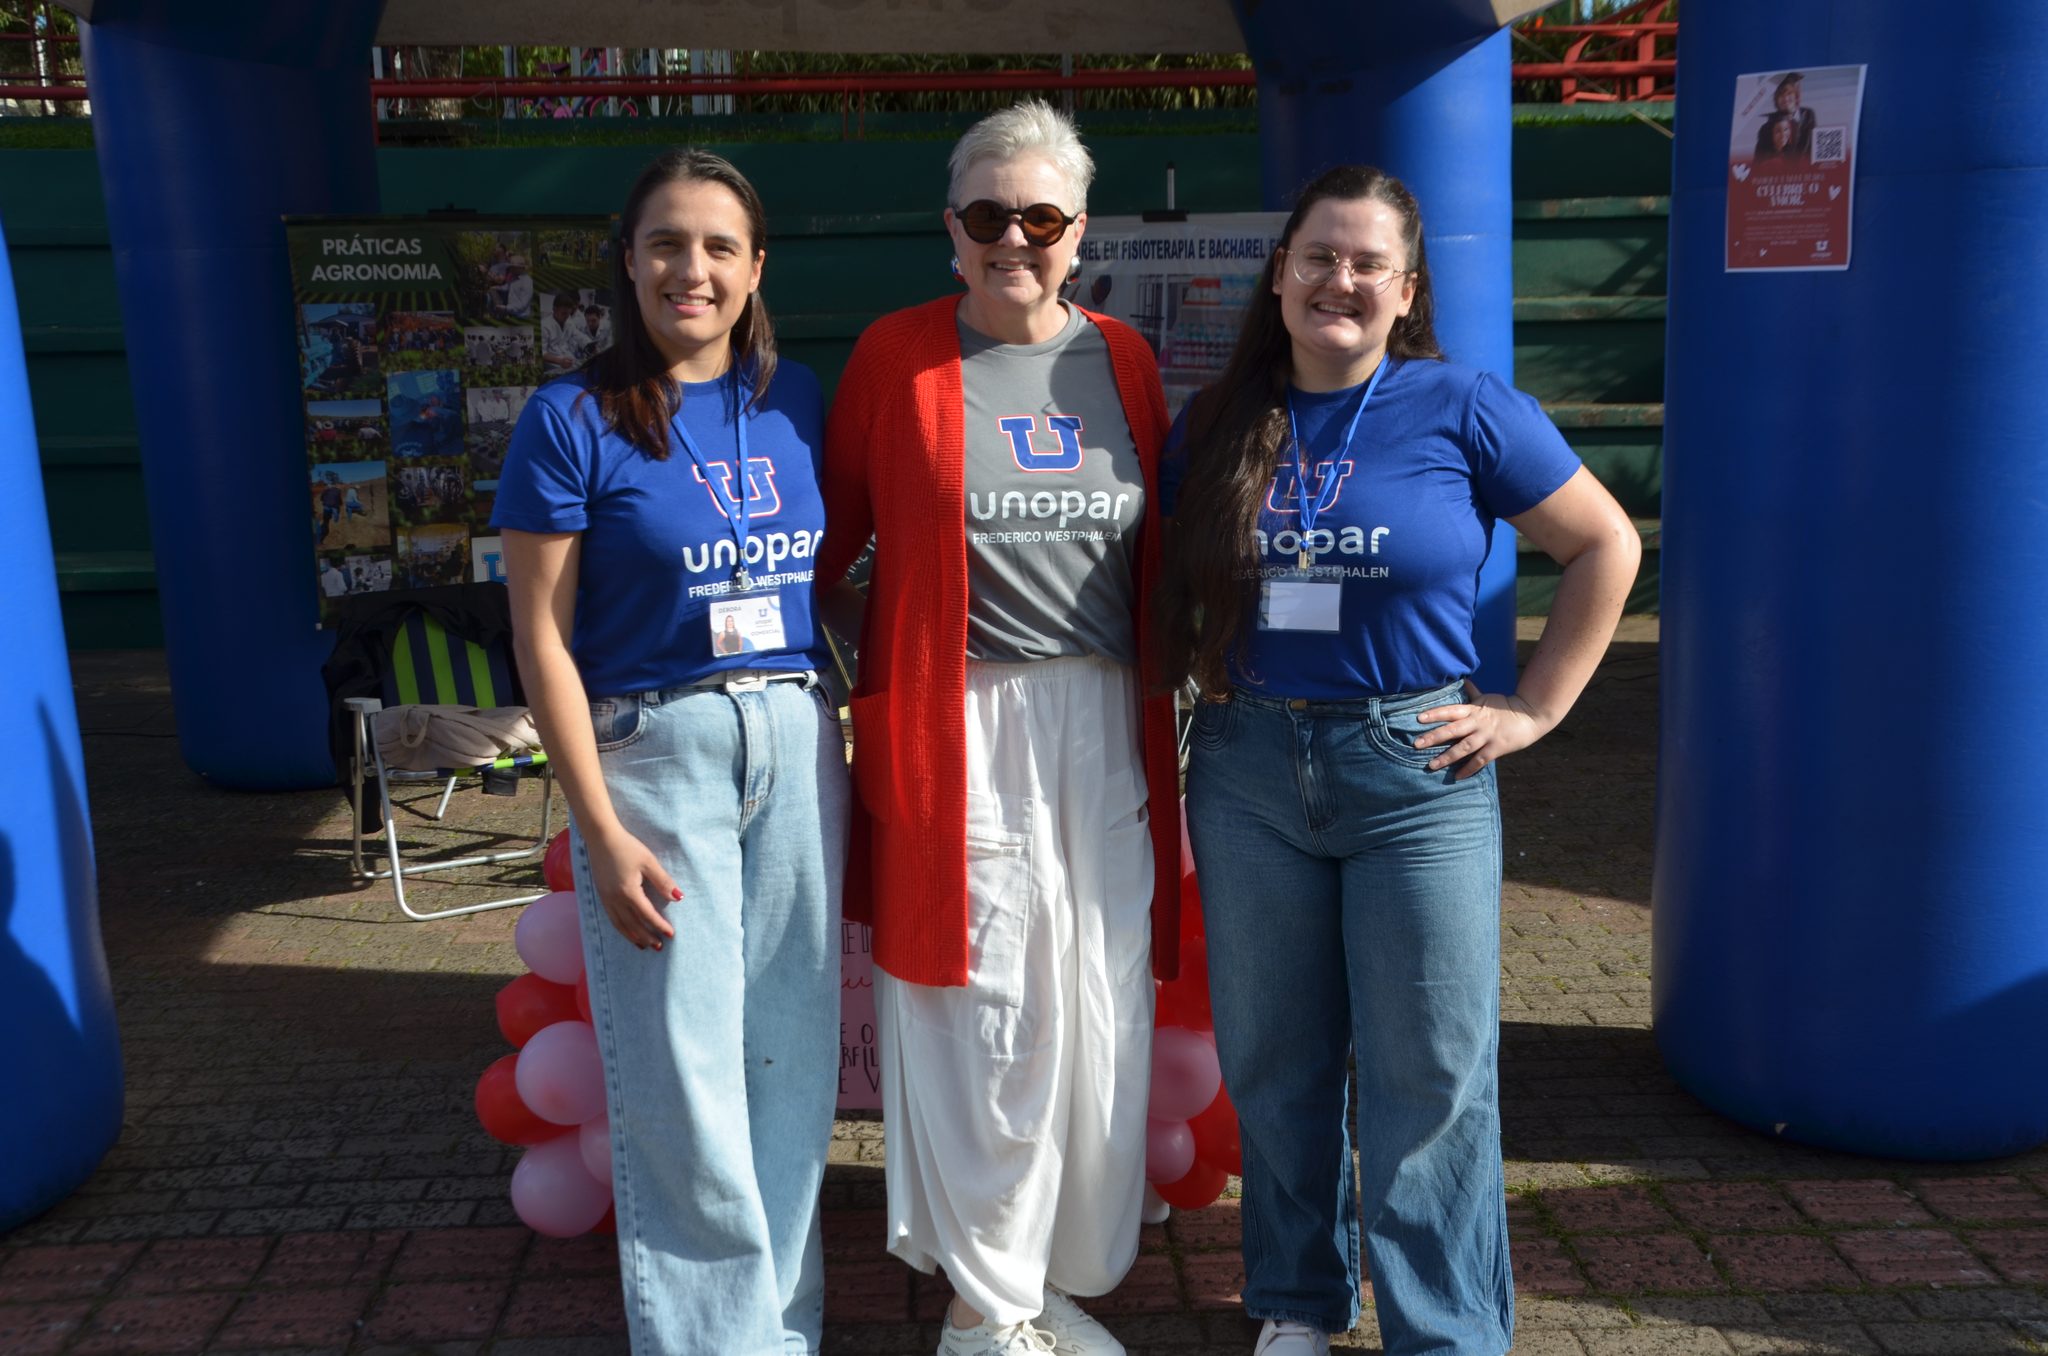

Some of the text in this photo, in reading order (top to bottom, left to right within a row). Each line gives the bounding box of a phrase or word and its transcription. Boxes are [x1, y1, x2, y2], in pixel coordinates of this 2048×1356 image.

[322, 233, 422, 256] PRÁTICAS
[1103, 240, 1119, 261] EM
[1121, 238, 1196, 261] FISIOTERAPIA
[1199, 239, 1206, 259] E
[1208, 238, 1266, 260] BACHAREL
[311, 263, 442, 281] AGRONOMIA
[970, 490, 1130, 529] unopar
[972, 530, 1122, 545] FREDERICO WESTPHALEN
[1253, 526, 1390, 564] nopar
[682, 529, 824, 573] unopar
[756, 569, 815, 587] WESTPHALE
